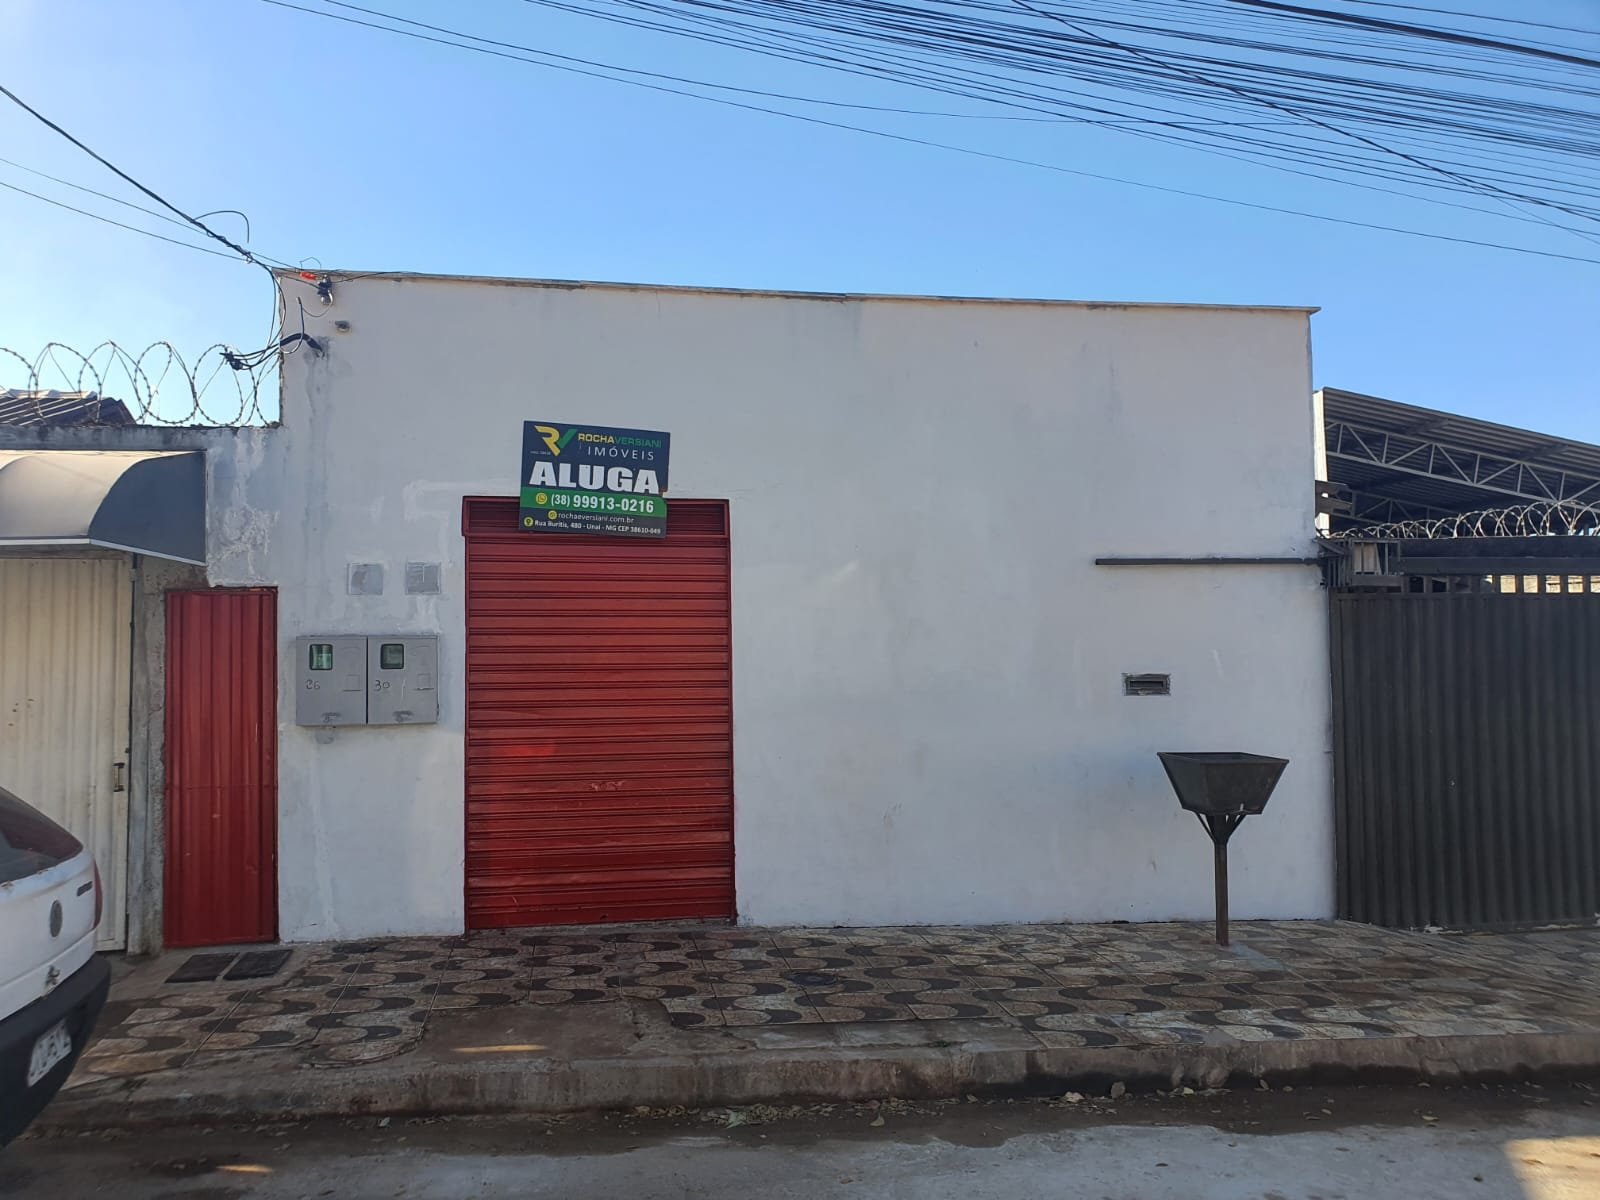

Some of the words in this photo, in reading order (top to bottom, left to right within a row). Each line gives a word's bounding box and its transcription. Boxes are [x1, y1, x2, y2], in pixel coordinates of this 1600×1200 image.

[578, 432, 662, 449] ROCHAVERSIANI
[587, 445, 654, 461] IMÓVEIS
[529, 460, 660, 495] ALUGA
[551, 494, 570, 507] (38)
[573, 494, 654, 513] 99913-0216
[534, 519, 546, 527] Rua
[558, 512, 634, 524] rochaeversiani.com.br
